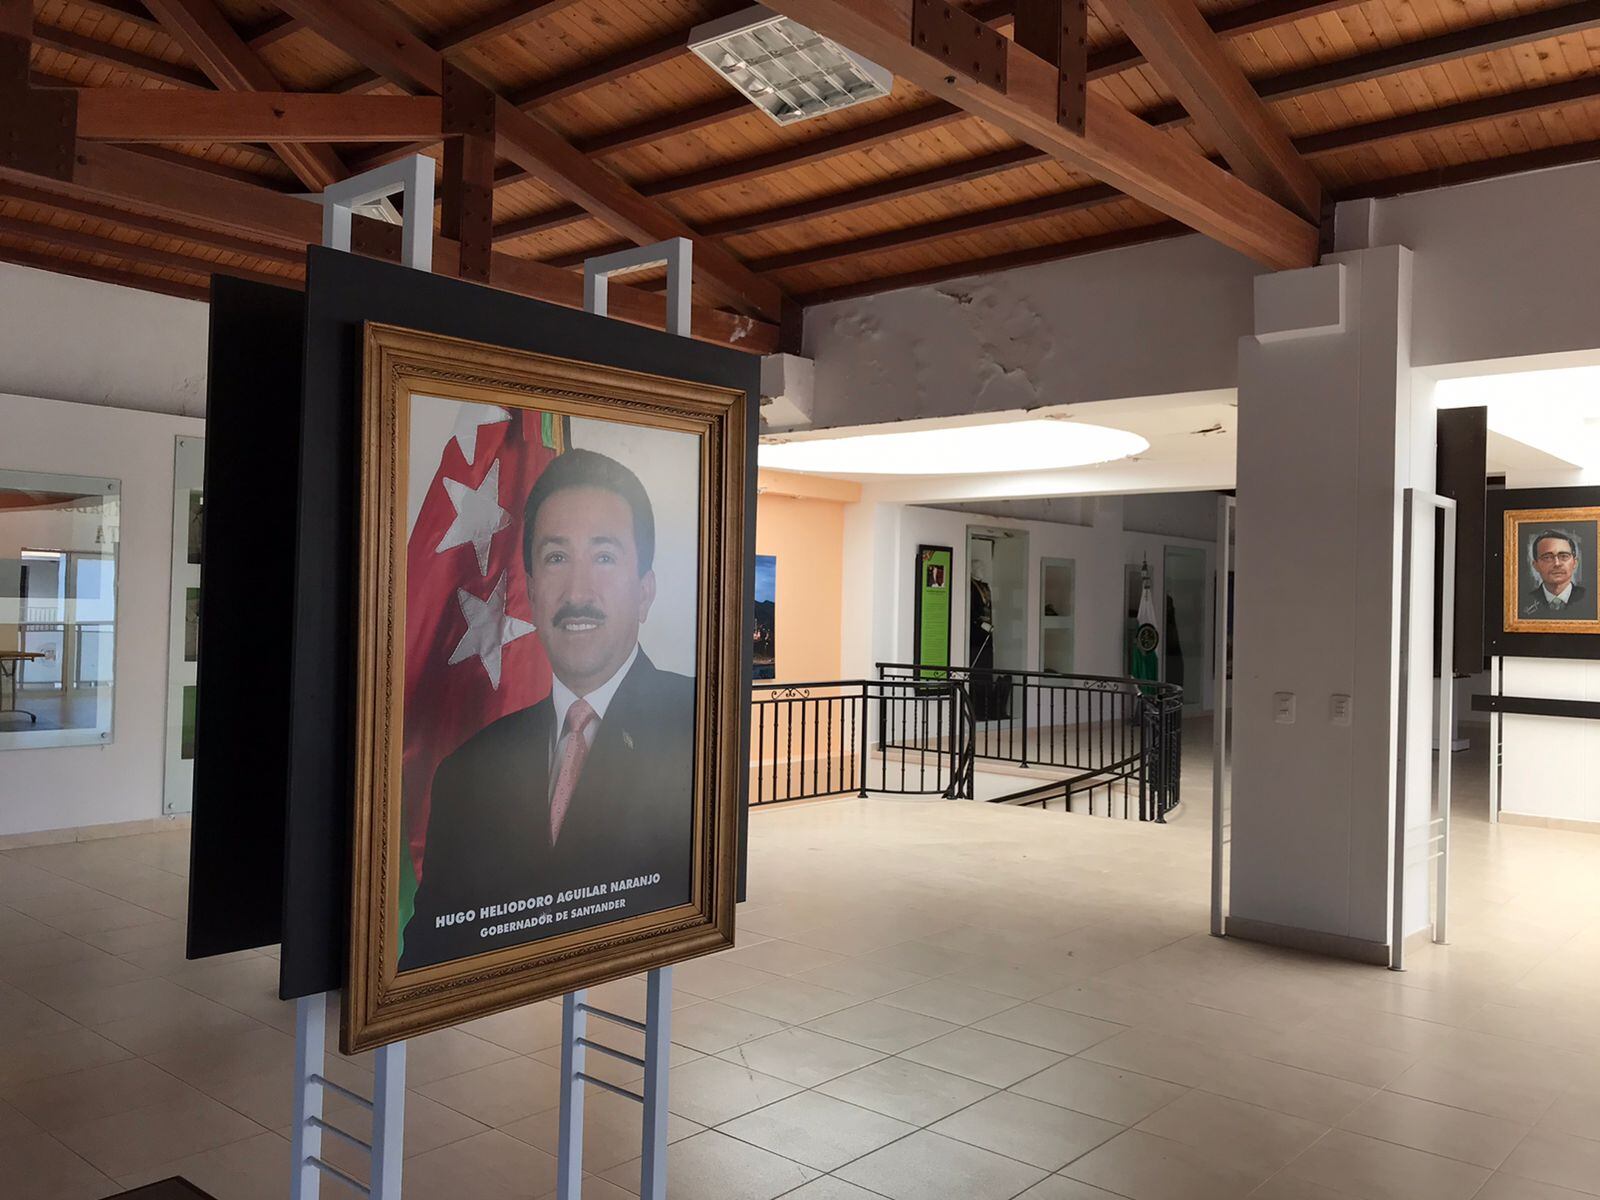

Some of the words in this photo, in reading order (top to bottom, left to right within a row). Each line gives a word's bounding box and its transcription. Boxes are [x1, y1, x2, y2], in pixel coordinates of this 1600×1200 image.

[435, 910, 476, 928] HUGO
[480, 894, 553, 919] HELIODORO
[556, 883, 608, 904] AGUILAR
[610, 873, 661, 893] NARANJO
[480, 911, 553, 938] GOBERNADOR
[555, 910, 569, 922] DE
[571, 898, 626, 918] SANTANDER
